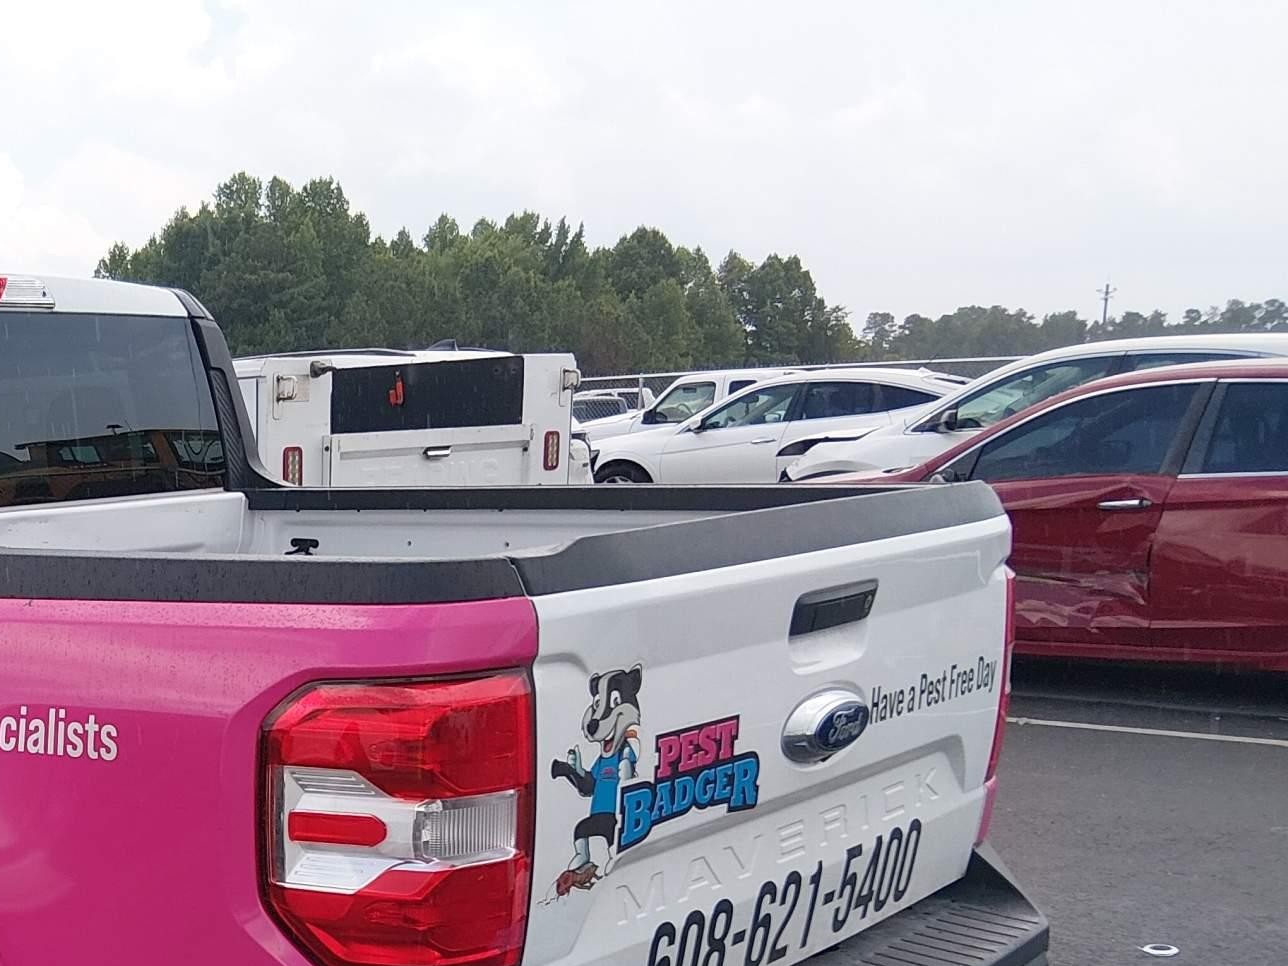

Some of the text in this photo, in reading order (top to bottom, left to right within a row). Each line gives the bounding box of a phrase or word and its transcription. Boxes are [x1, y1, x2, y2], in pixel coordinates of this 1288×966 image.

[869, 656, 997, 724] Have a Pest Free Day
[657, 719, 738, 779] PEST
[827, 707, 864, 744] Ford
[620, 757, 758, 846] BADGER
[615, 768, 940, 926] MAVERICK
